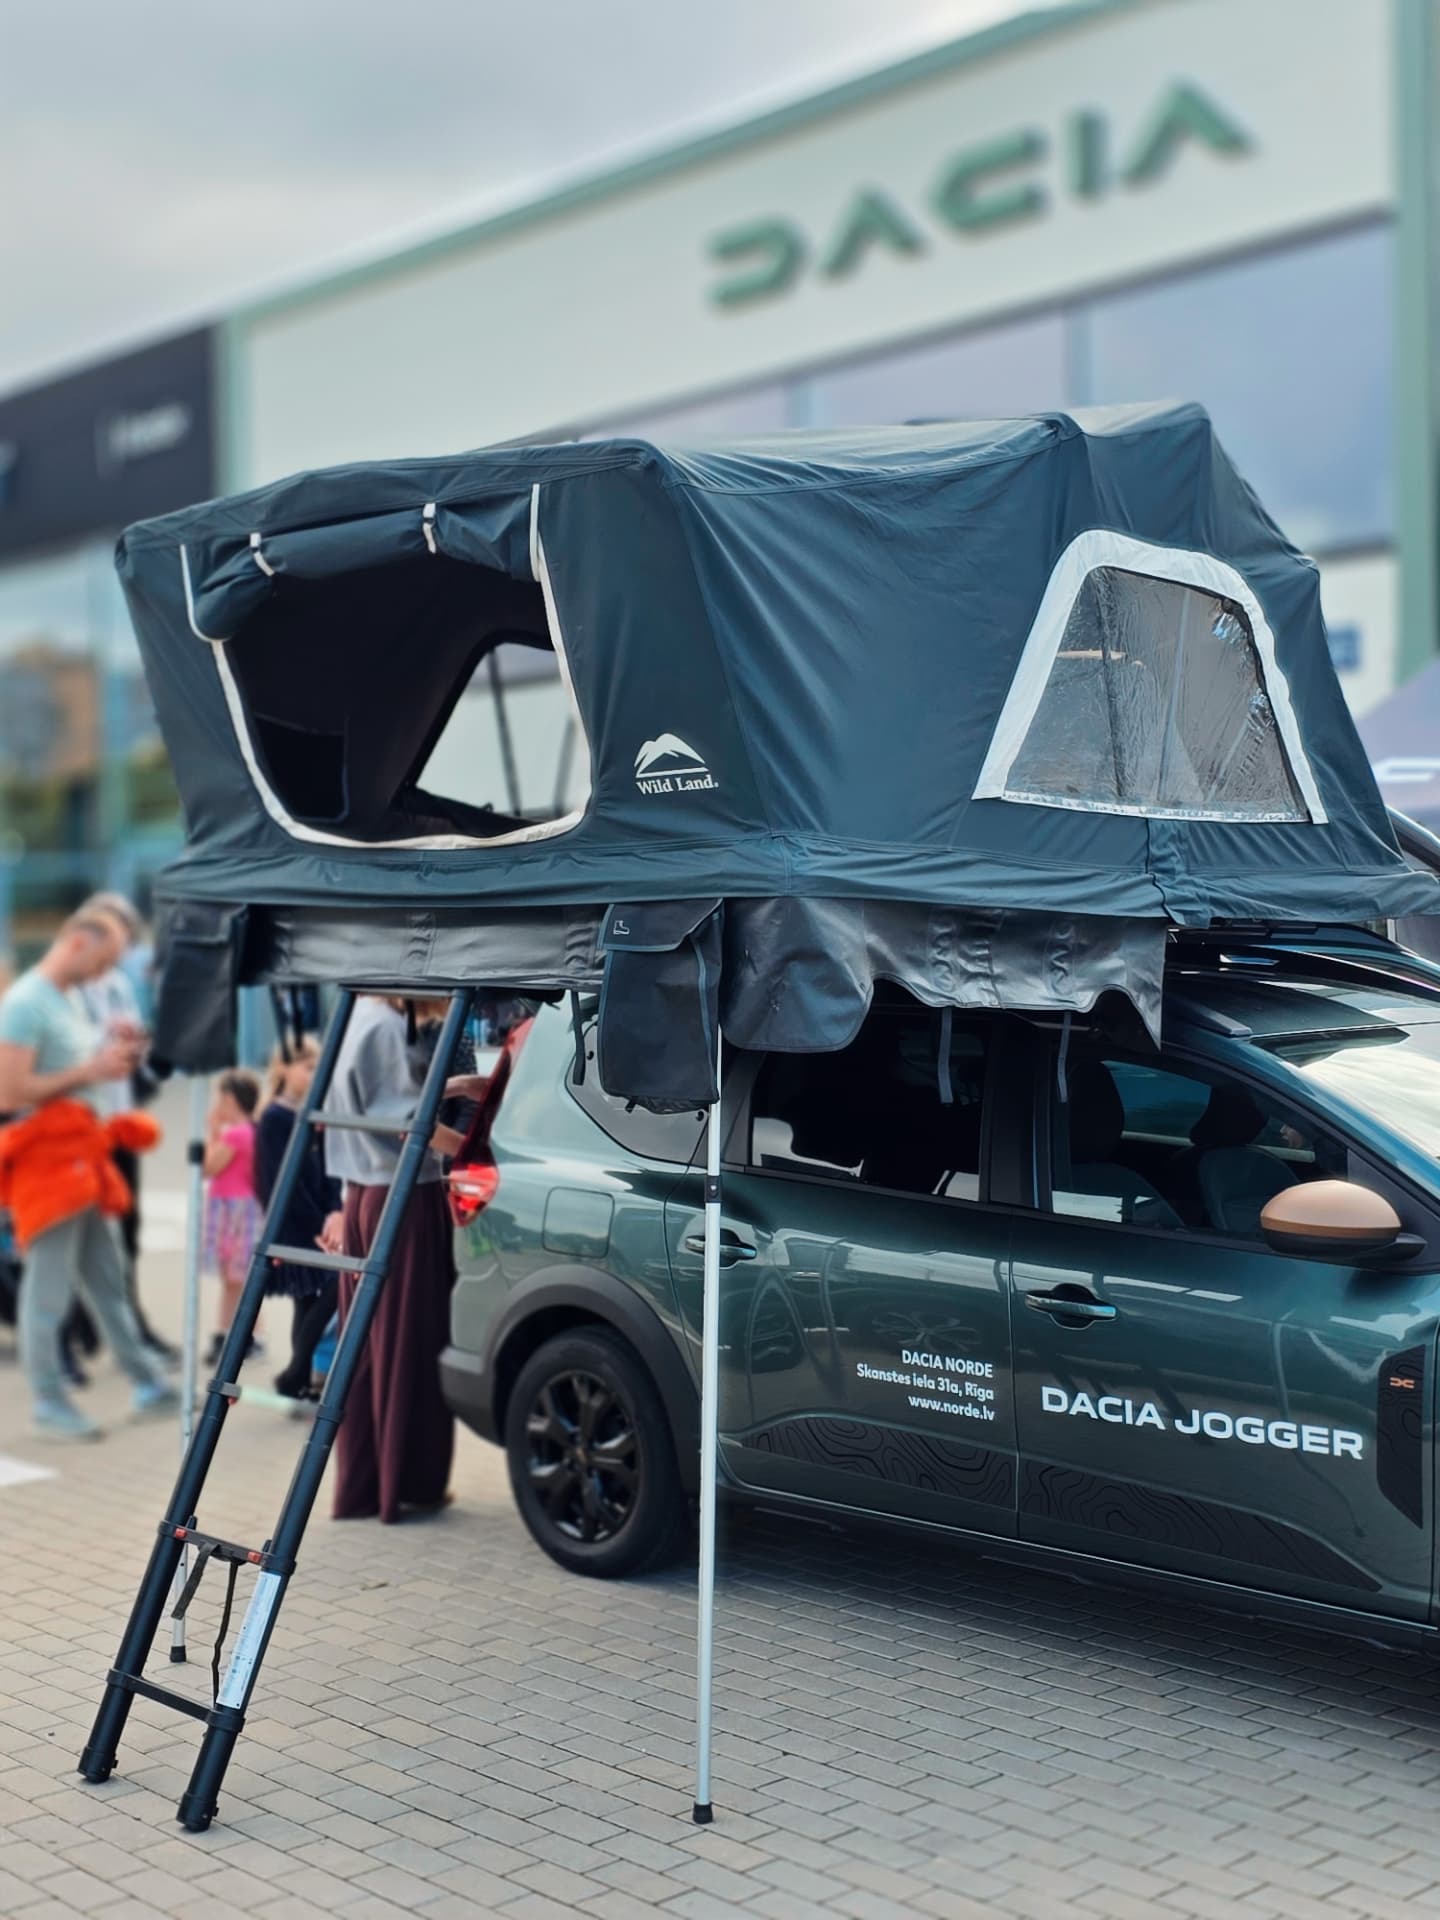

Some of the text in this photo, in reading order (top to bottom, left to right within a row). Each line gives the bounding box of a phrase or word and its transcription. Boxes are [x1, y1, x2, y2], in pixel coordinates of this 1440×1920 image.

[709, 78, 1257, 312] DACIA
[636, 779, 673, 795] Wild
[902, 1349, 993, 1378] DACIA NORDE
[856, 1363, 994, 1402] Skanstes iela 31a, Rīga
[908, 1396, 995, 1421] www.norde.lv
[1041, 1386, 1364, 1460] DACIA JOGGER
